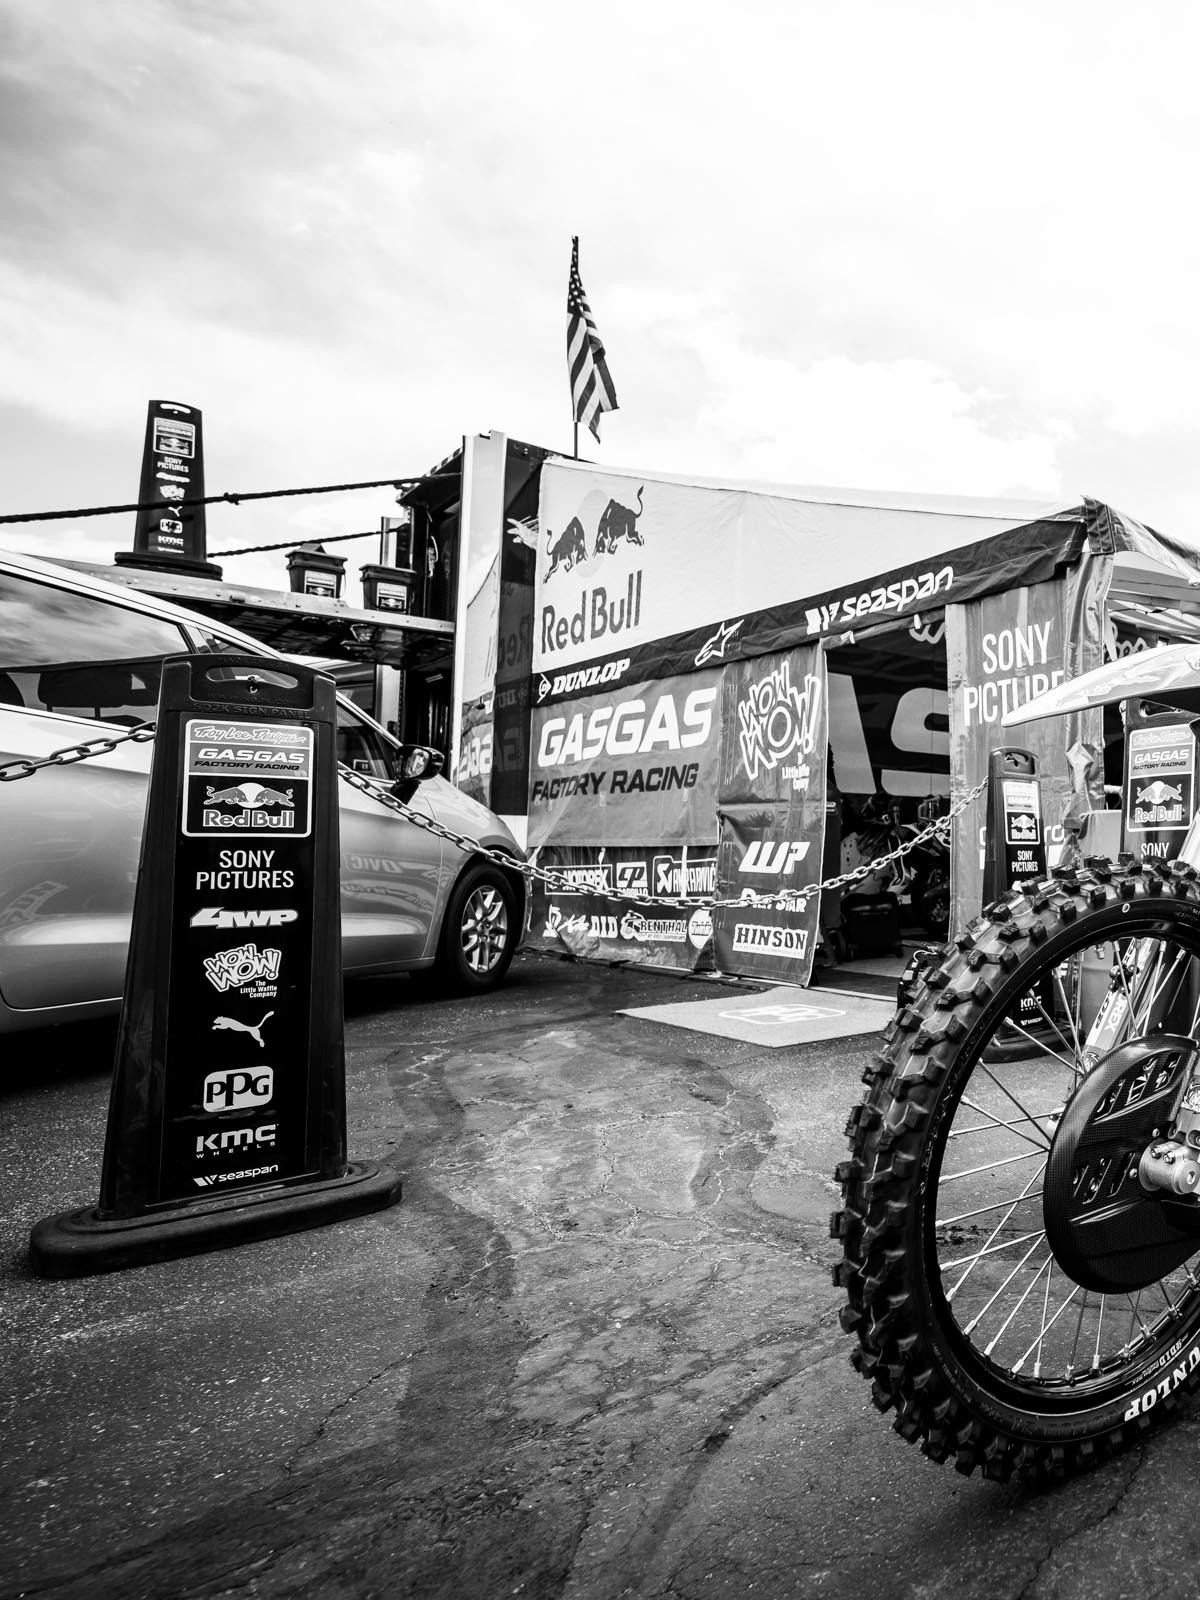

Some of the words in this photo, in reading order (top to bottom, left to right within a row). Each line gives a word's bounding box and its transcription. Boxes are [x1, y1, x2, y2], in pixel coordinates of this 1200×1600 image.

[839, 566, 954, 618] seaspan
[541, 590, 586, 654] Red
[590, 570, 643, 640] Bull
[982, 621, 1051, 674] SONY
[551, 658, 630, 695] DUNLOP
[963, 669, 1065, 727] PICTUR
[537, 687, 718, 768] GASGAS
[194, 760, 253, 768] FACTORY
[255, 763, 300, 771] RACING
[198, 747, 305, 764] GASGAS
[1134, 749, 1190, 763] GASGAS
[532, 771, 605, 804] FACTORY
[609, 762, 700, 795] RACING
[203, 808, 250, 828] Red
[251, 810, 294, 828] Bull
[1134, 805, 1157, 823] Red
[1157, 803, 1183, 822] Bull
[219, 849, 275, 868] SONY
[1017, 850, 1033, 861] SONY
[1011, 861, 1038, 872] PICTURES
[196, 870, 294, 890] PICTURES
[641, 921, 688, 934] RENTHAL
[736, 926, 806, 950] HINSON
[258, 985, 278, 993] Waffle
[206, 1072, 270, 1107] PPG
[218, 1164, 279, 1182] seaspan
